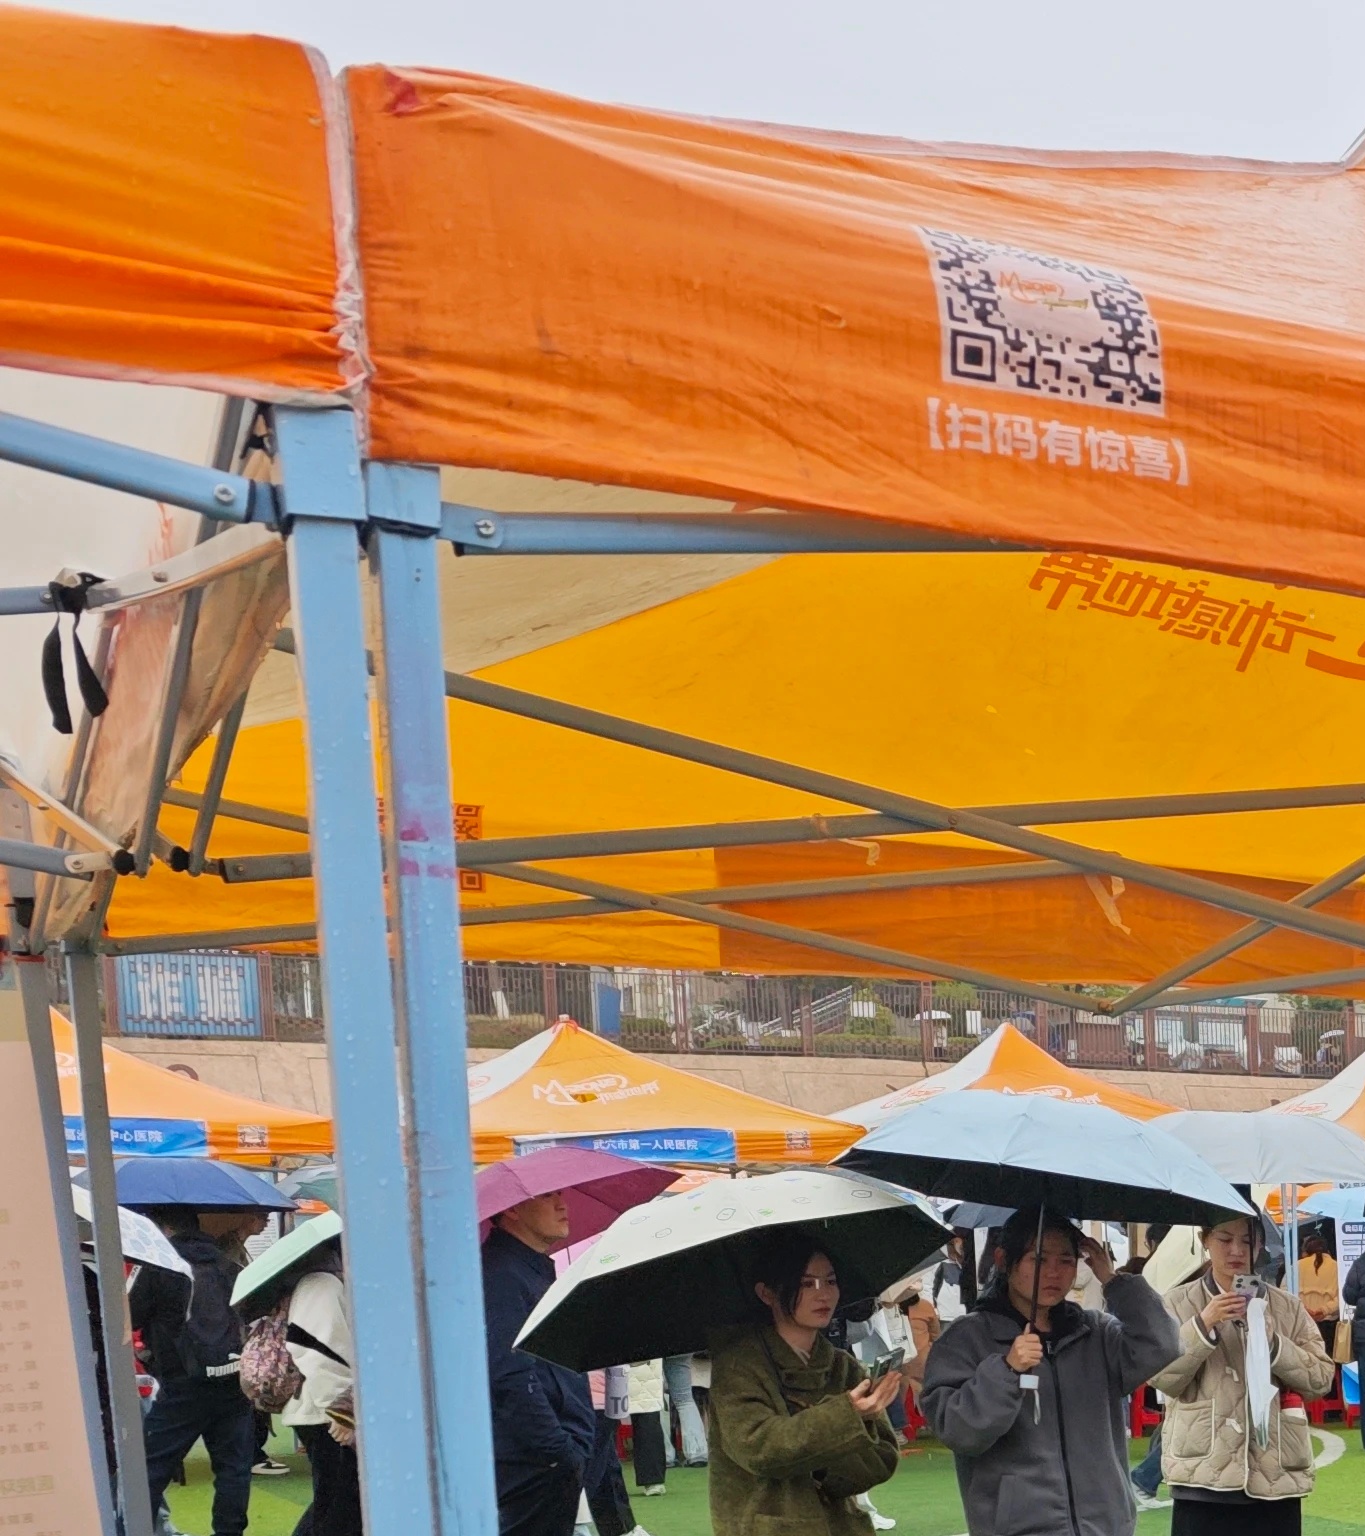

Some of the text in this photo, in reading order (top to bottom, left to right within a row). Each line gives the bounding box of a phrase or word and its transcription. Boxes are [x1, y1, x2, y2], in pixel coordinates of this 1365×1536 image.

[927, 397, 1189, 485] 【扫码有惊喜】
[592, 1138, 699, 1151] 武穴市第一人民医院
